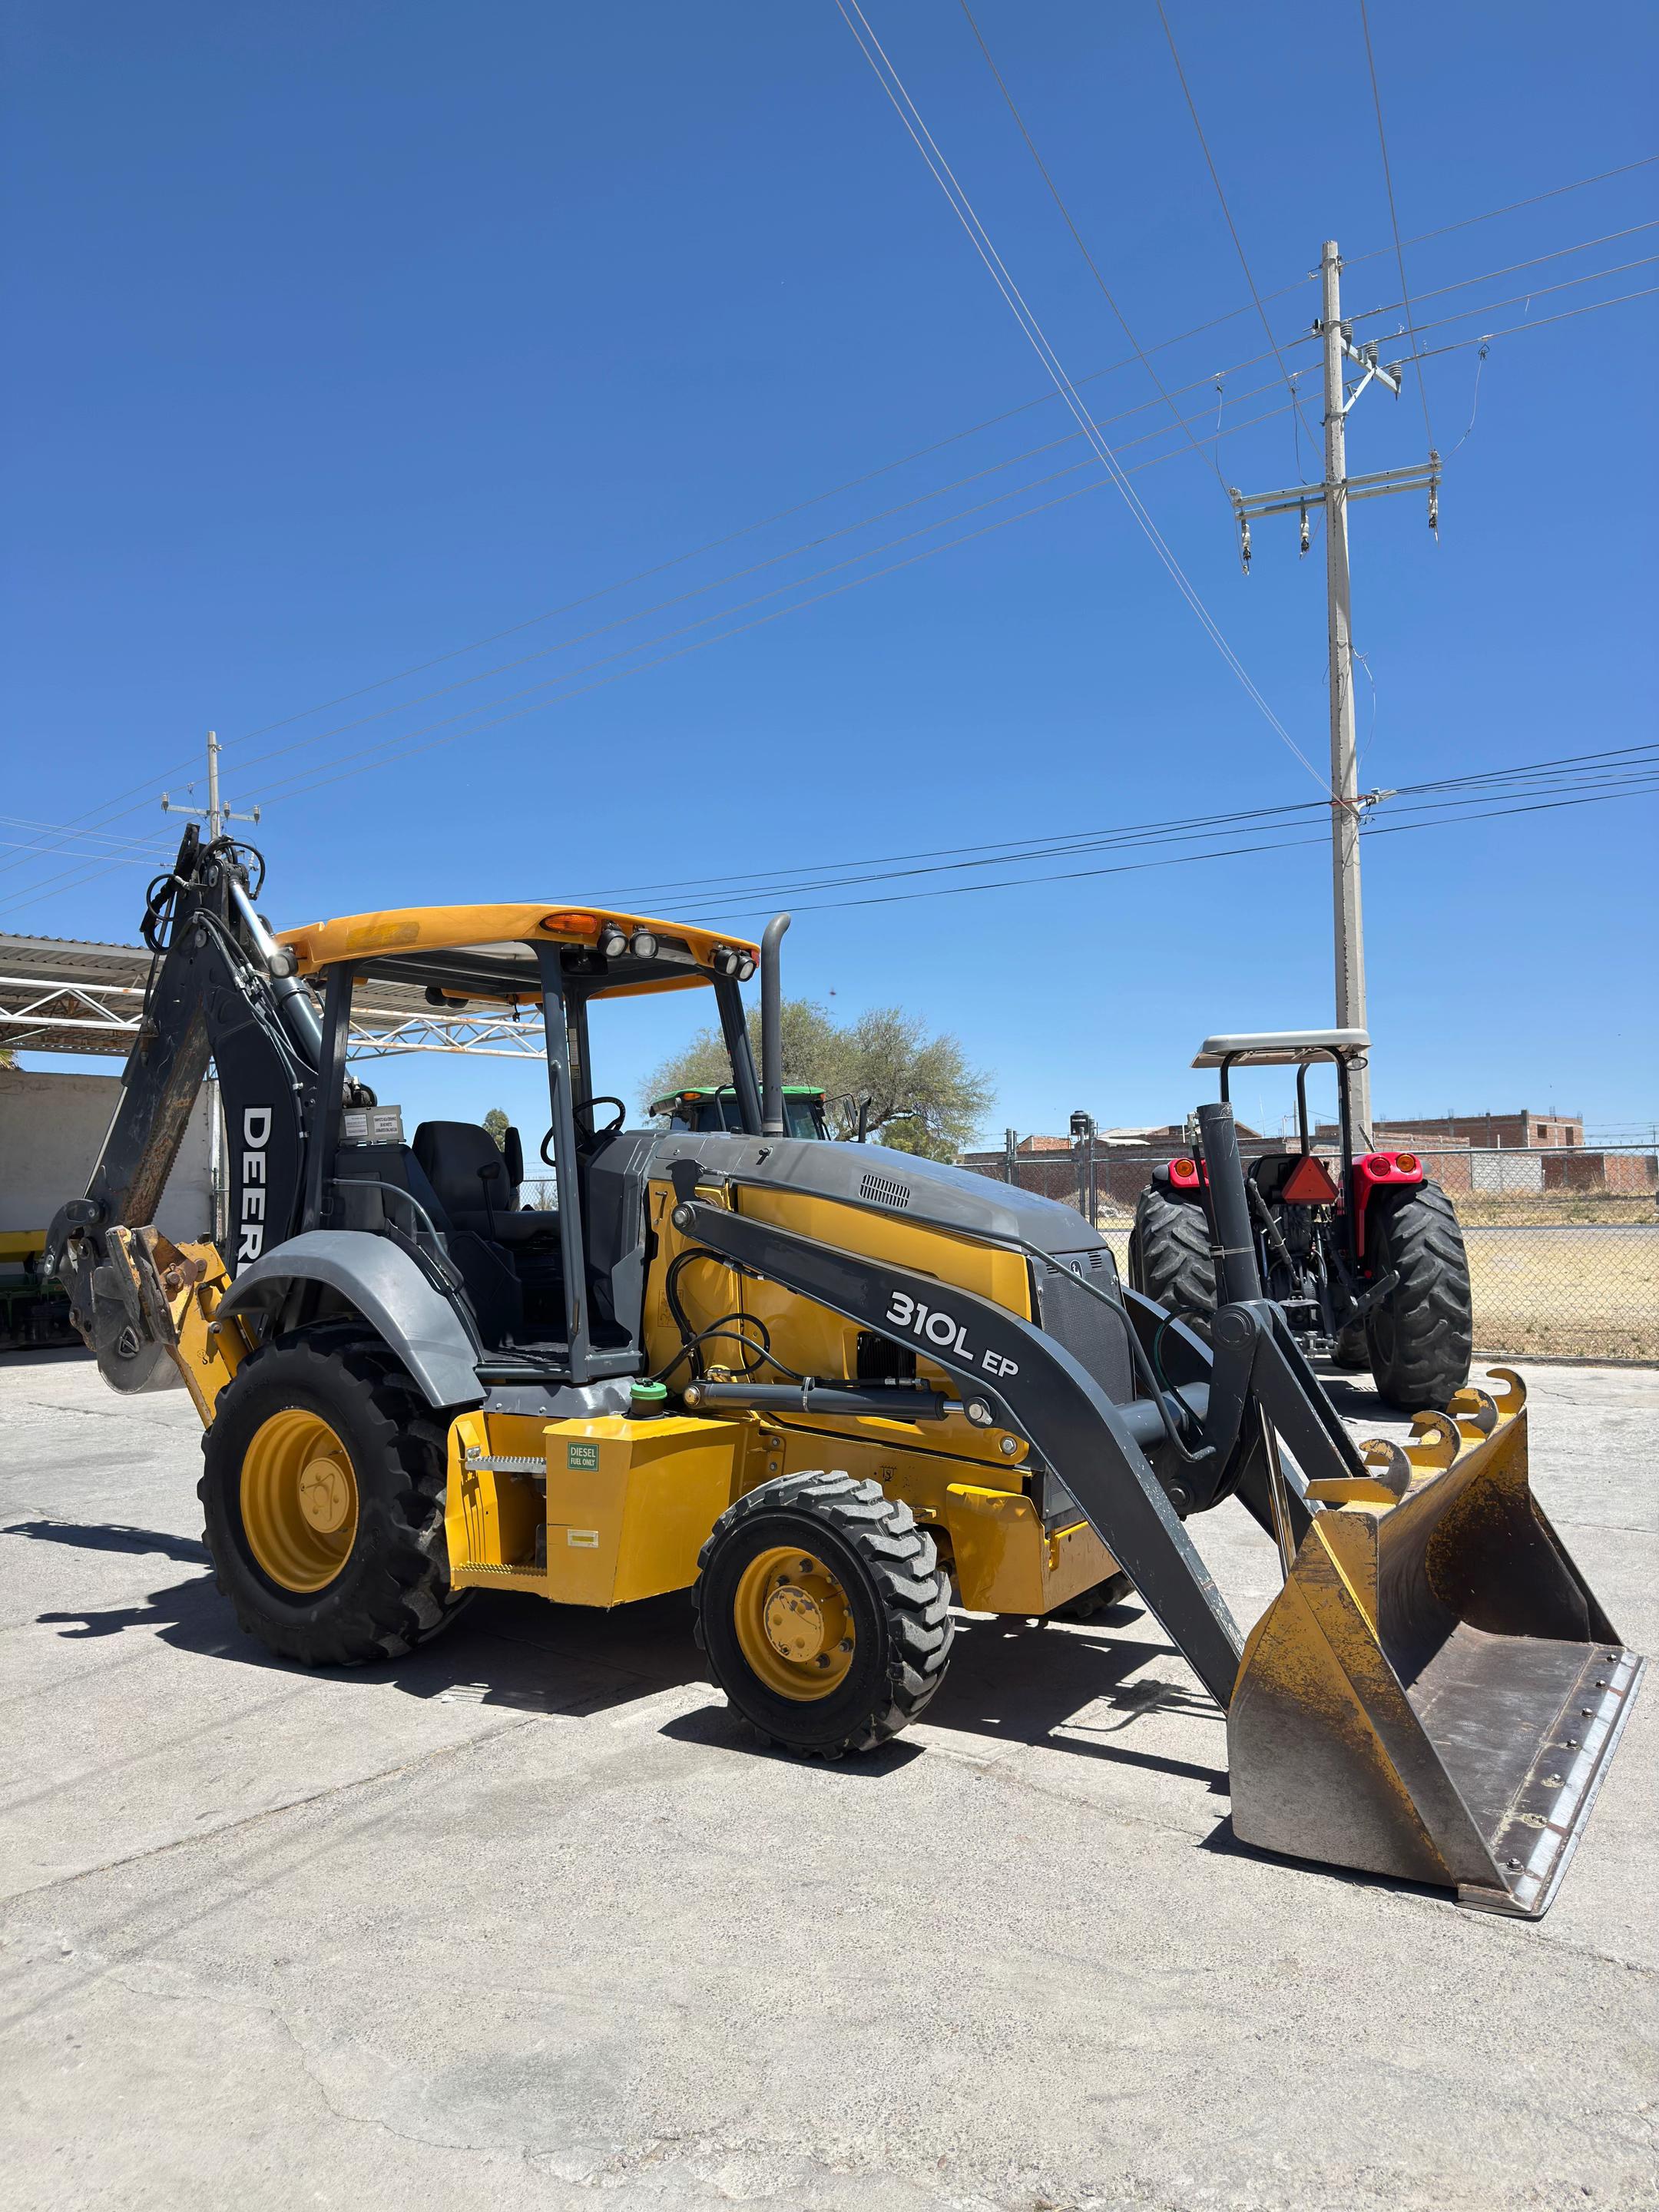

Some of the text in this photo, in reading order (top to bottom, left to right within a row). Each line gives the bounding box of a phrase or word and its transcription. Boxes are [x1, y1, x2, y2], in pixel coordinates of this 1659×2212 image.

[886, 1291, 1019, 1378] 310L EP
[571, 1446, 596, 1458] DIESEL
[571, 1457, 581, 1465] FUEL
